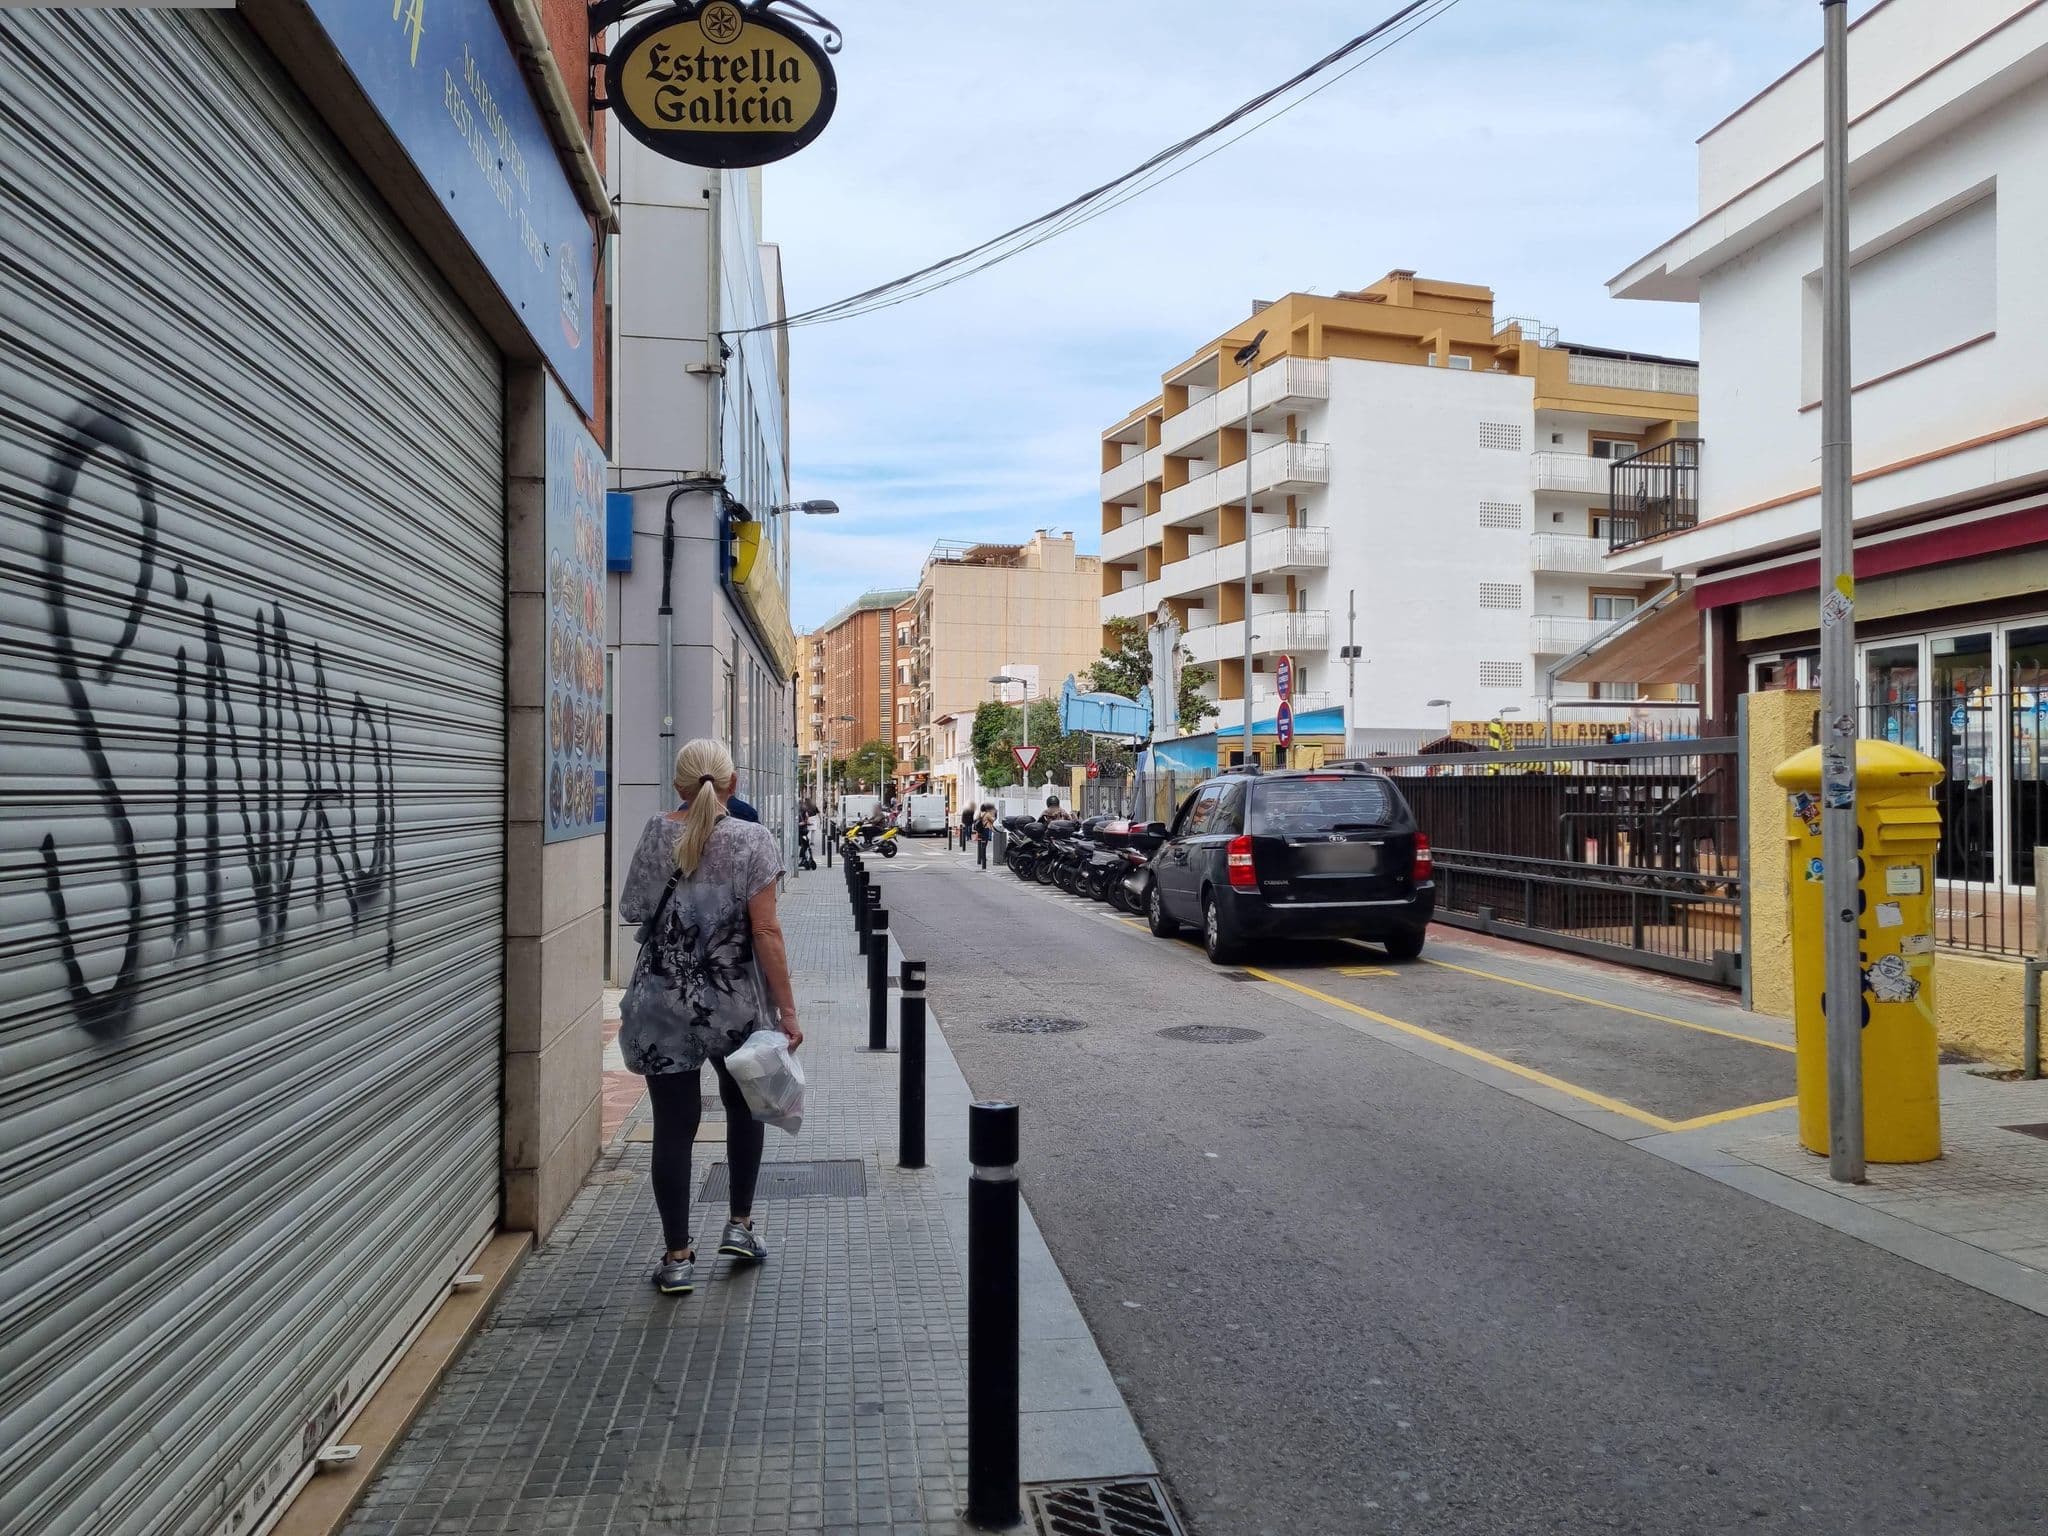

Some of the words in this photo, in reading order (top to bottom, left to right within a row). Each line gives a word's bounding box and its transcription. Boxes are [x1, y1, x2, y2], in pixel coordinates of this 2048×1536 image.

[646, 43, 801, 84] Estrella
[463, 42, 531, 204] MARISQUERIA
[654, 84, 795, 125] Galicia
[443, 67, 513, 220] RESTAURANT
[1471, 722, 1535, 736] RACHO
